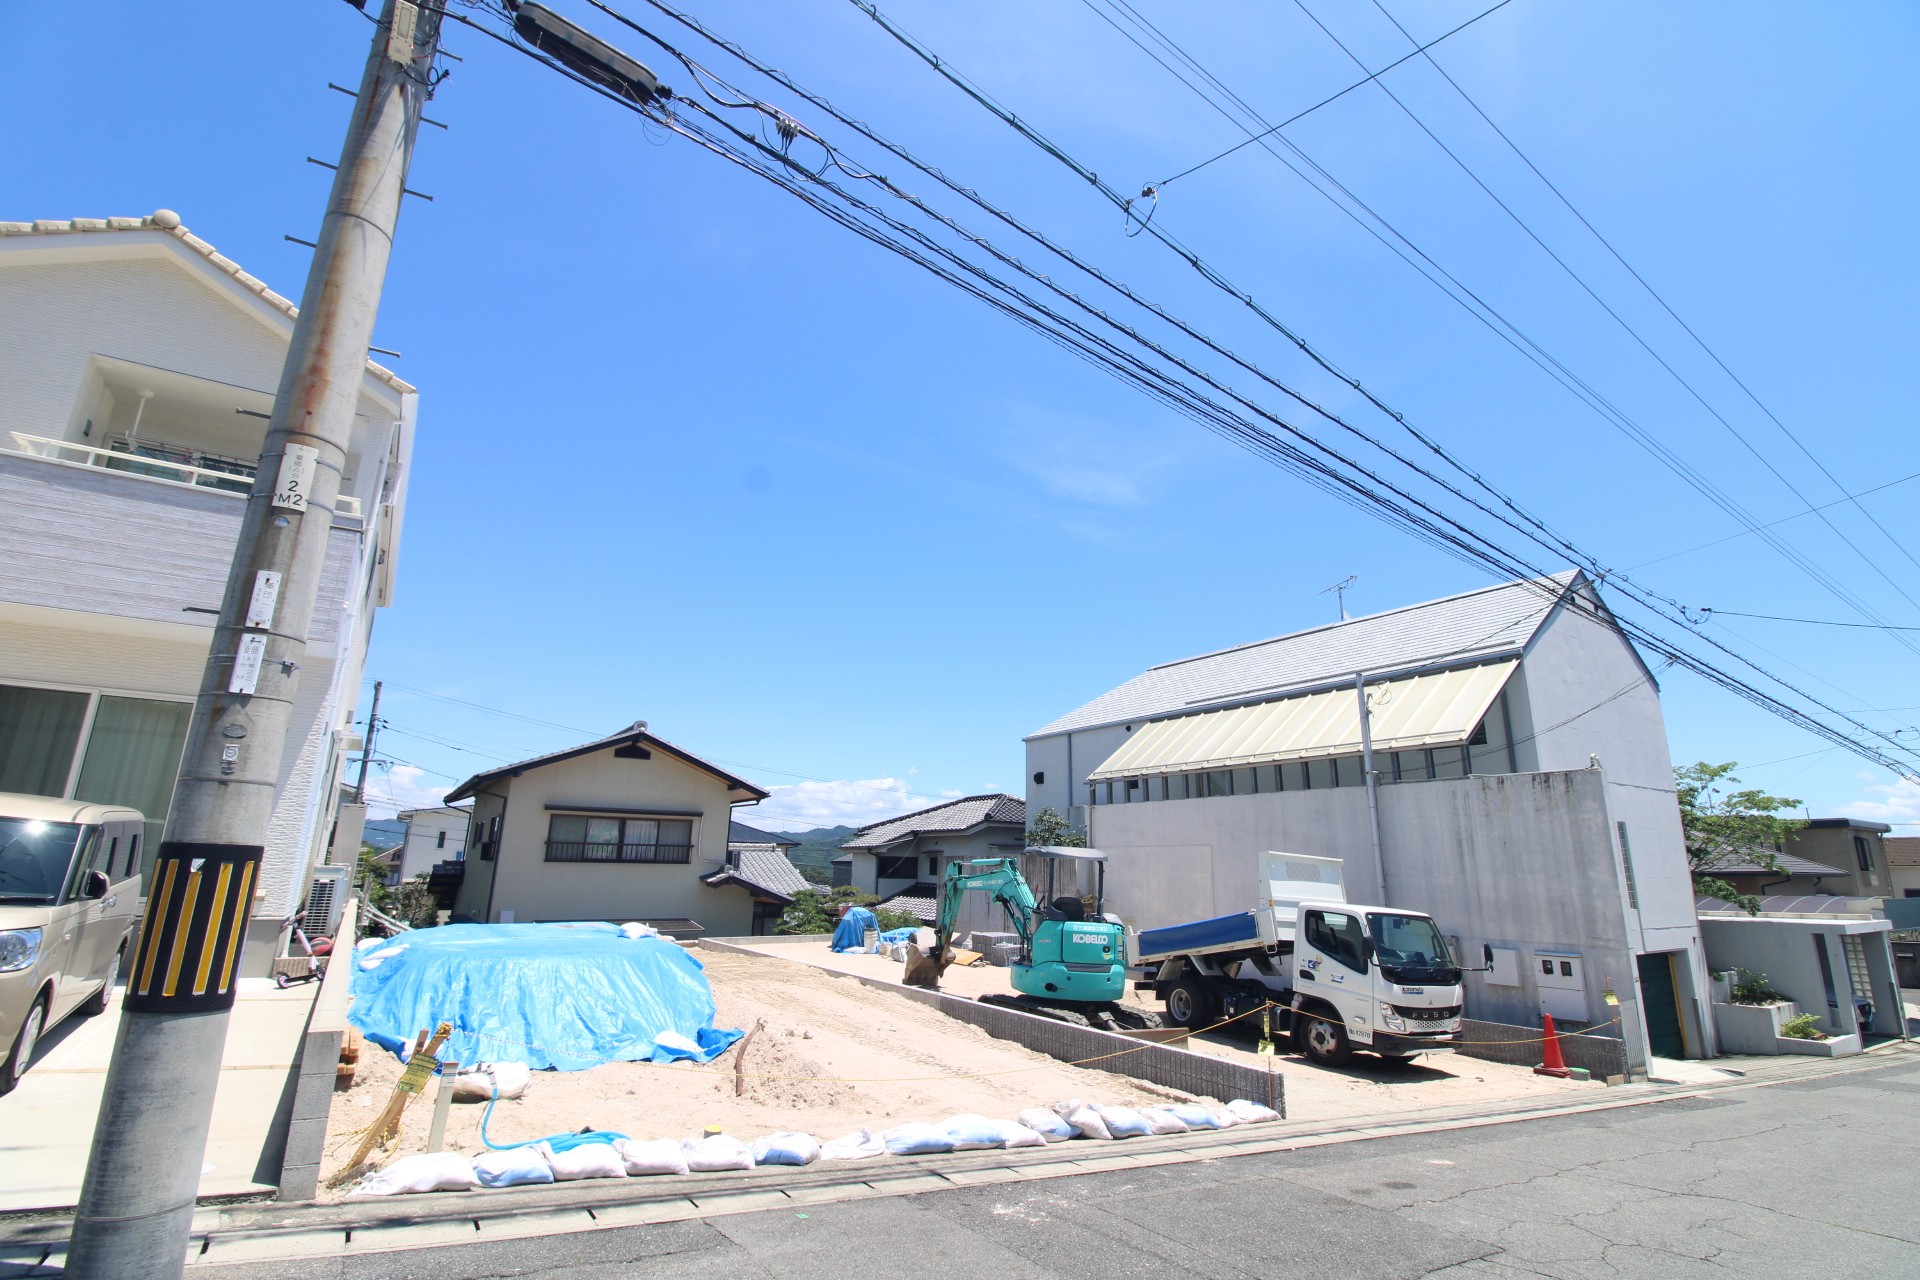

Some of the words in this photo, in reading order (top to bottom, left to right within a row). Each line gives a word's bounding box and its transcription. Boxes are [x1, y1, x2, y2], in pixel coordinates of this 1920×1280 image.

[287, 480, 299, 492] 2
[277, 493, 303, 506] M2
[1072, 933, 1109, 945] KOBELCO
[1412, 1011, 1450, 1019] FUSO
